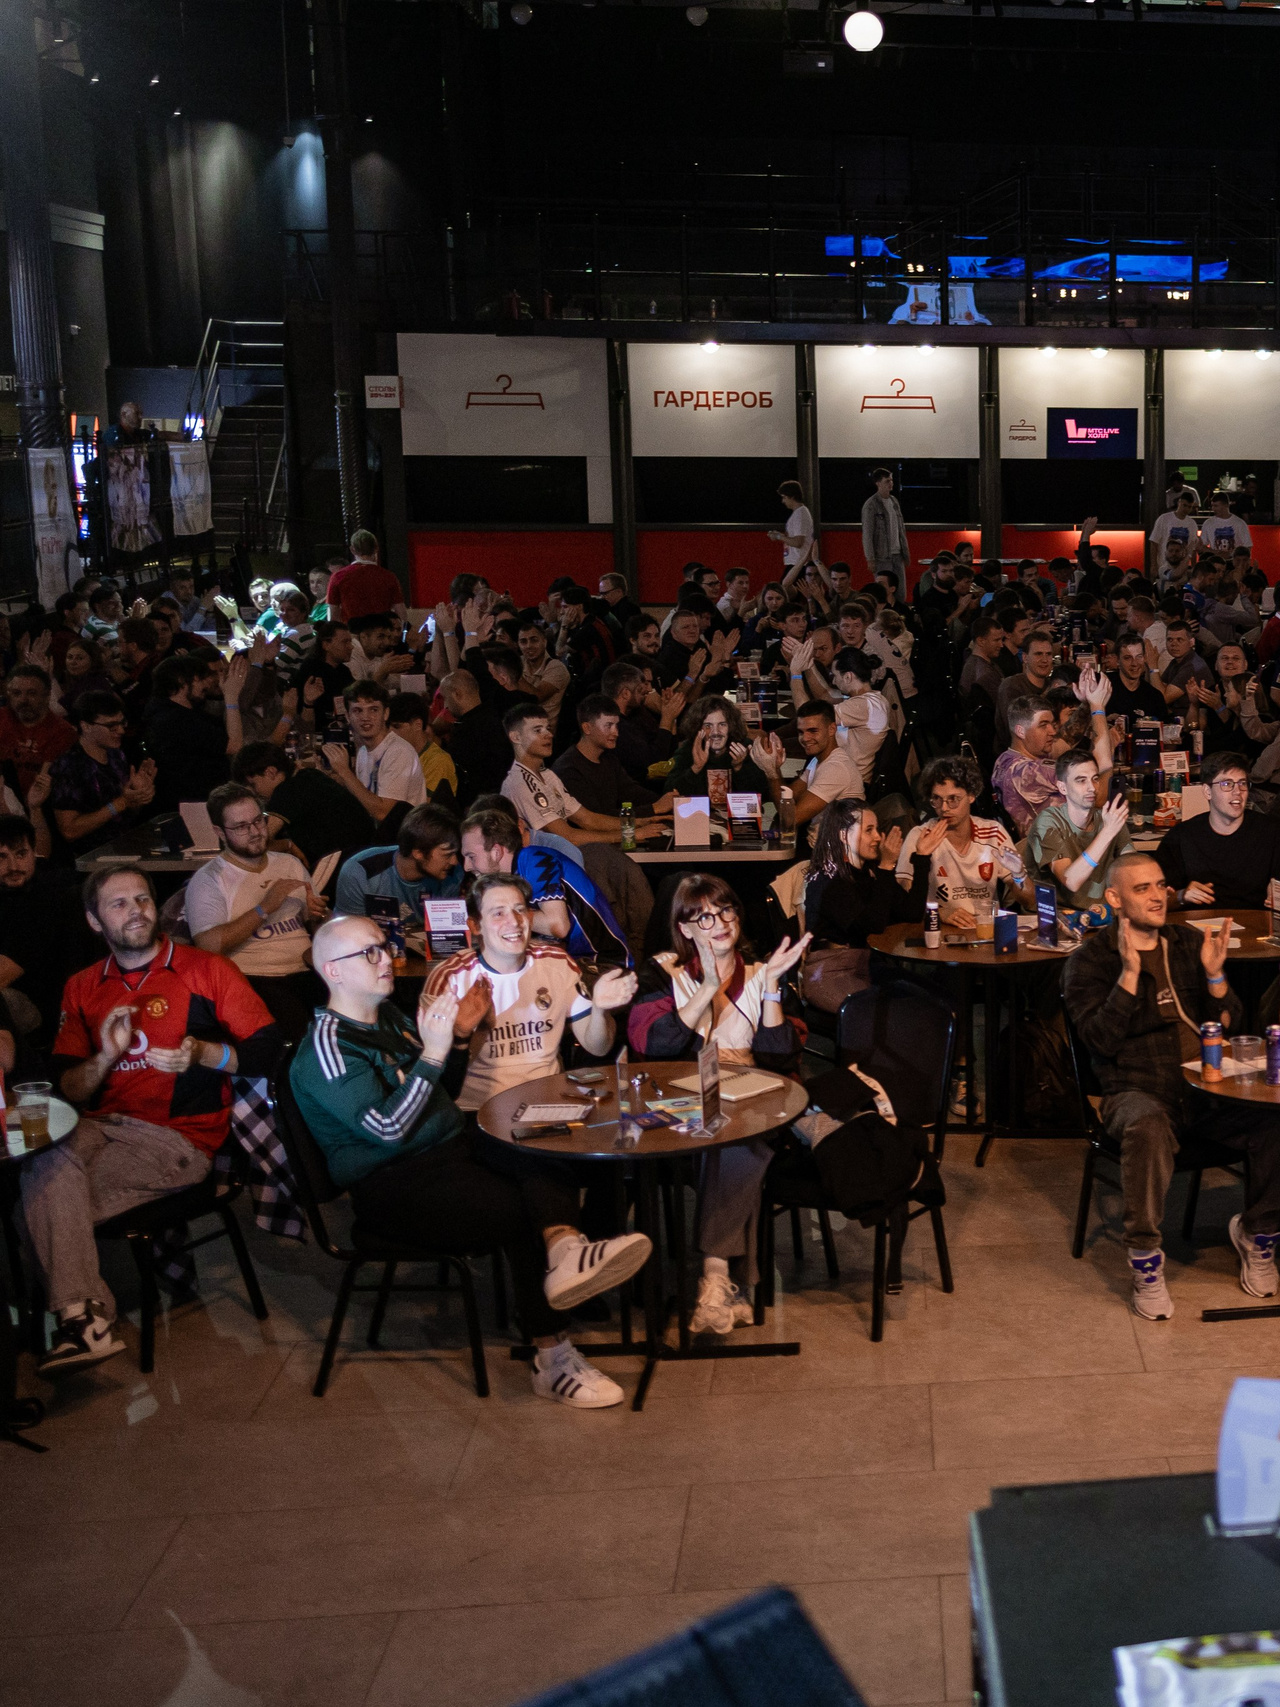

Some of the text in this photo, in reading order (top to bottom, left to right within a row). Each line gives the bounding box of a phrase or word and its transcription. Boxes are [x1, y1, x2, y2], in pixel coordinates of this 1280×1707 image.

[654, 391, 773, 411] ГАРДЕРОБ
[952, 886, 988, 894] standard
[952, 891, 990, 901] chartered
[489, 1019, 554, 1042] mirates
[489, 1036, 543, 1058] FLY BETTER
